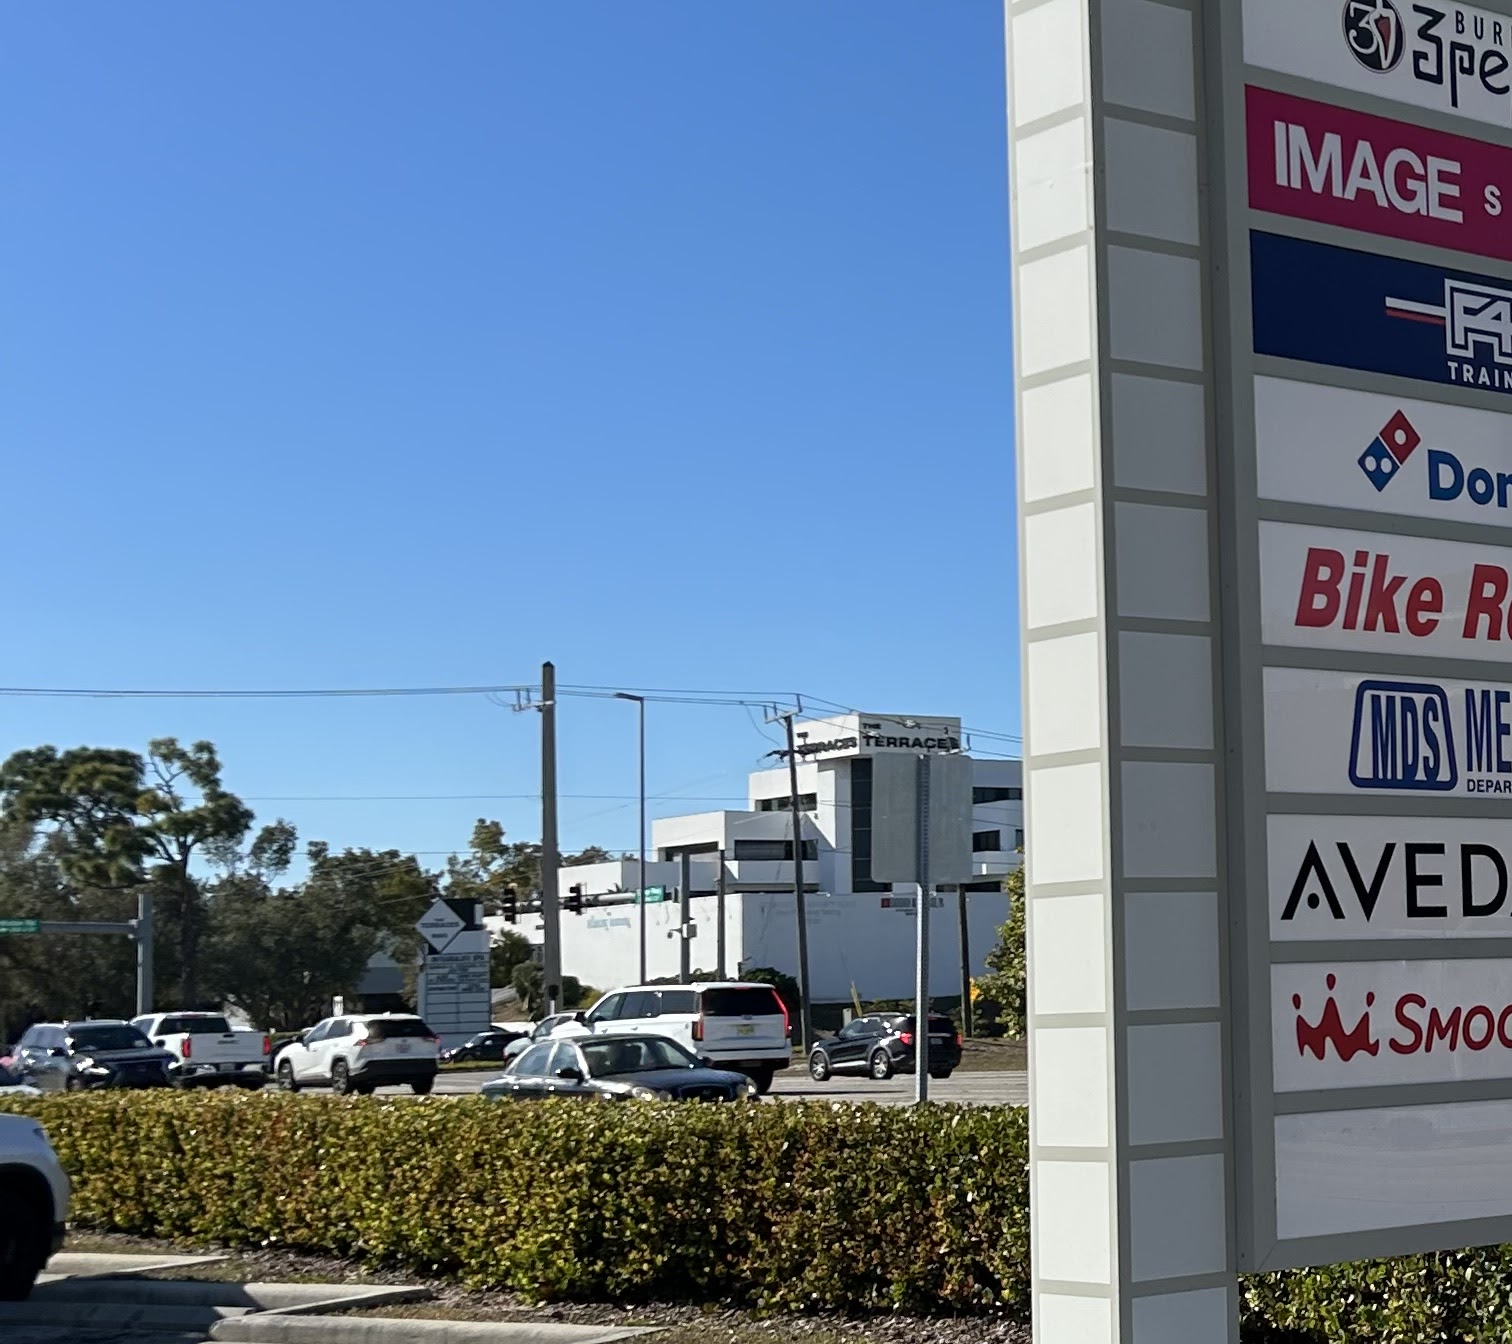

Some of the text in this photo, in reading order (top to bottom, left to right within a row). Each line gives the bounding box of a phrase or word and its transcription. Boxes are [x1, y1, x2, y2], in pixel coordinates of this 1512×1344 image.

[1274, 120, 1464, 225] IMAGE
[1294, 547, 1444, 637] Bike
[1370, 693, 1440, 782] MDS
